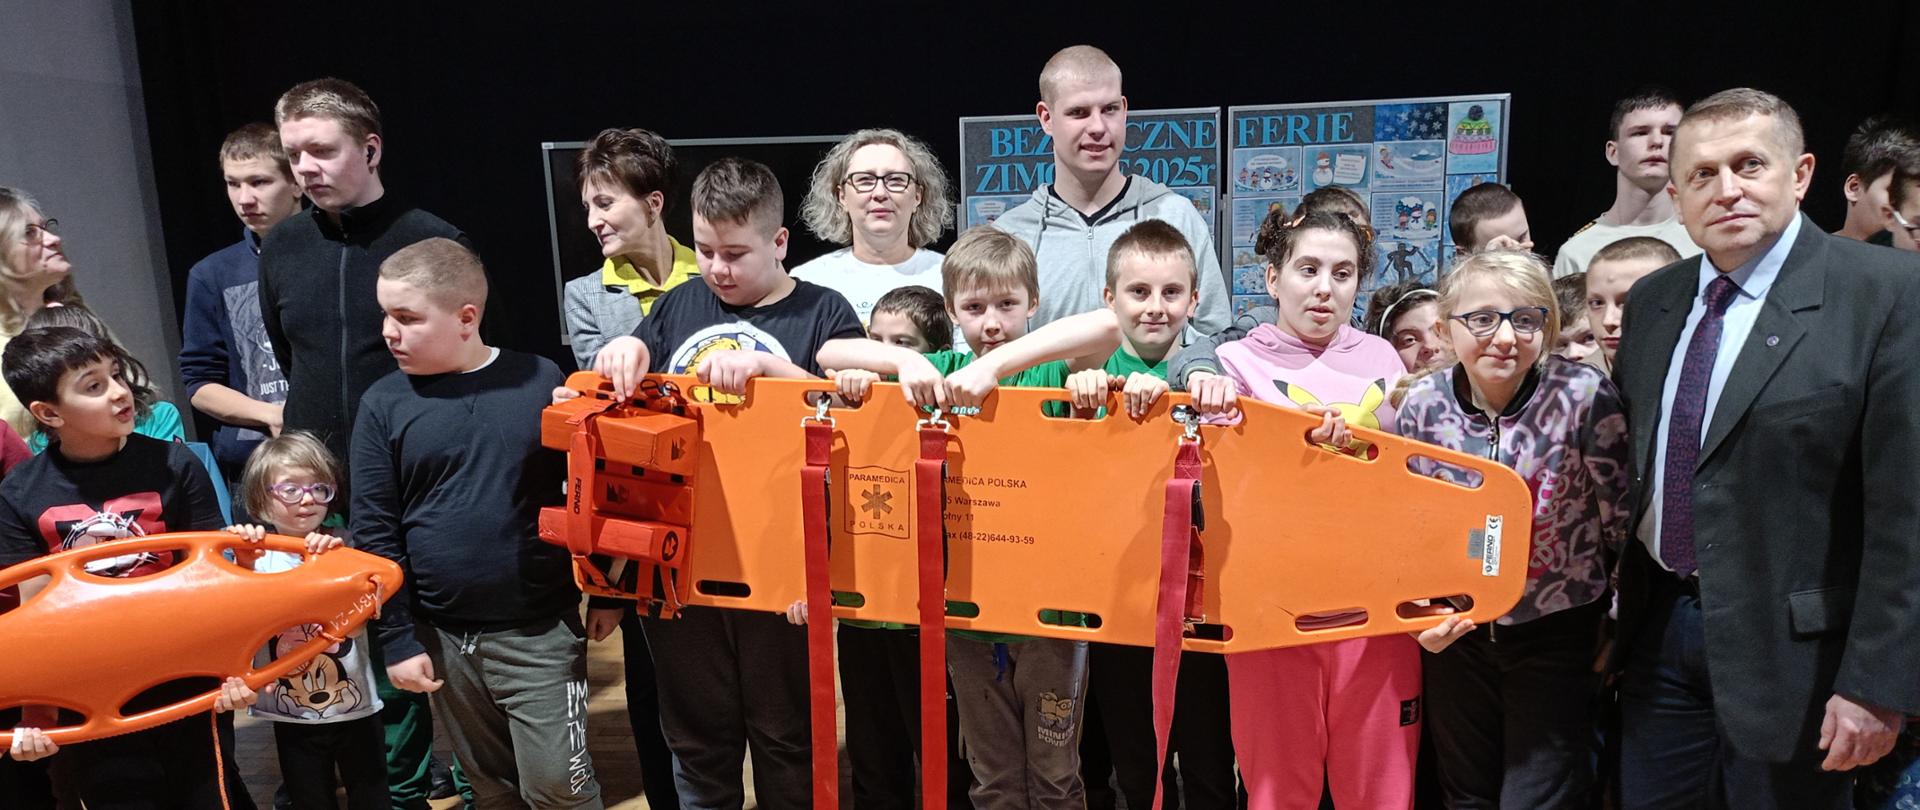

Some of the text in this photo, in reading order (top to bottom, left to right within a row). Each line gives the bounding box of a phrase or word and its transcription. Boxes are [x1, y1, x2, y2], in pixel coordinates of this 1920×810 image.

[1236, 112, 1353, 147] FERIE
[260, 381, 277, 395] JUST
[849, 473, 905, 484] PARAMEDICA
[946, 476, 1027, 489] MEDICA POLSKA
[573, 477, 582, 515] FERNO
[954, 496, 1001, 507] Warszawa
[964, 513, 974, 521] 11
[850, 520, 905, 532] POLSKA
[959, 531, 1035, 545] (48-22)644-93-59
